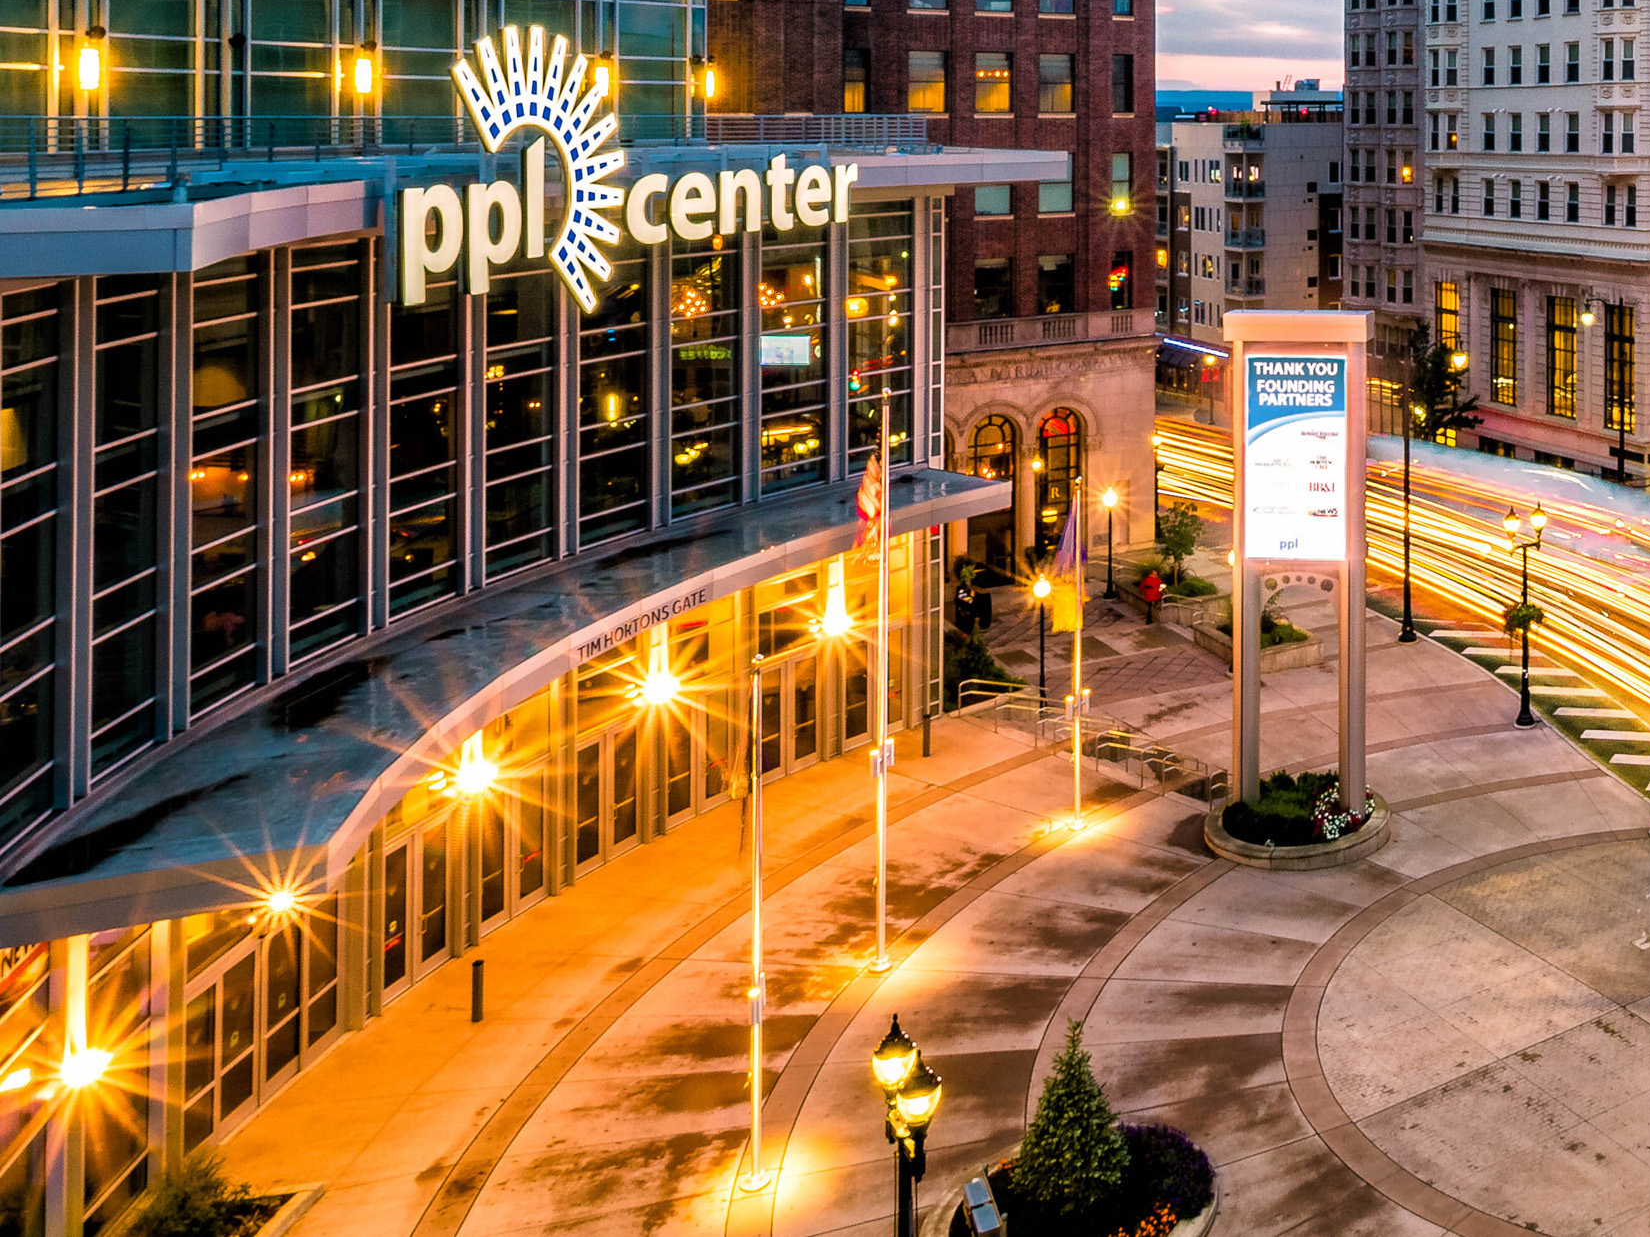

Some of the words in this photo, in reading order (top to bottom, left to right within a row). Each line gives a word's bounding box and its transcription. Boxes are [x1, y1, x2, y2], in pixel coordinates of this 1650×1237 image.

[402, 136, 545, 306] ppl
[626, 153, 859, 245] center
[1253, 362, 1305, 375] THANK
[1307, 362, 1338, 376] YOU
[1256, 379, 1336, 393] FOUNDING
[1258, 392, 1333, 407] PARTNERS
[1051, 487, 1060, 498] R
[1280, 538, 1299, 550] ppl
[577, 637, 601, 662] TIM
[604, 604, 670, 648] HORTONS
[672, 588, 707, 615] GATE
